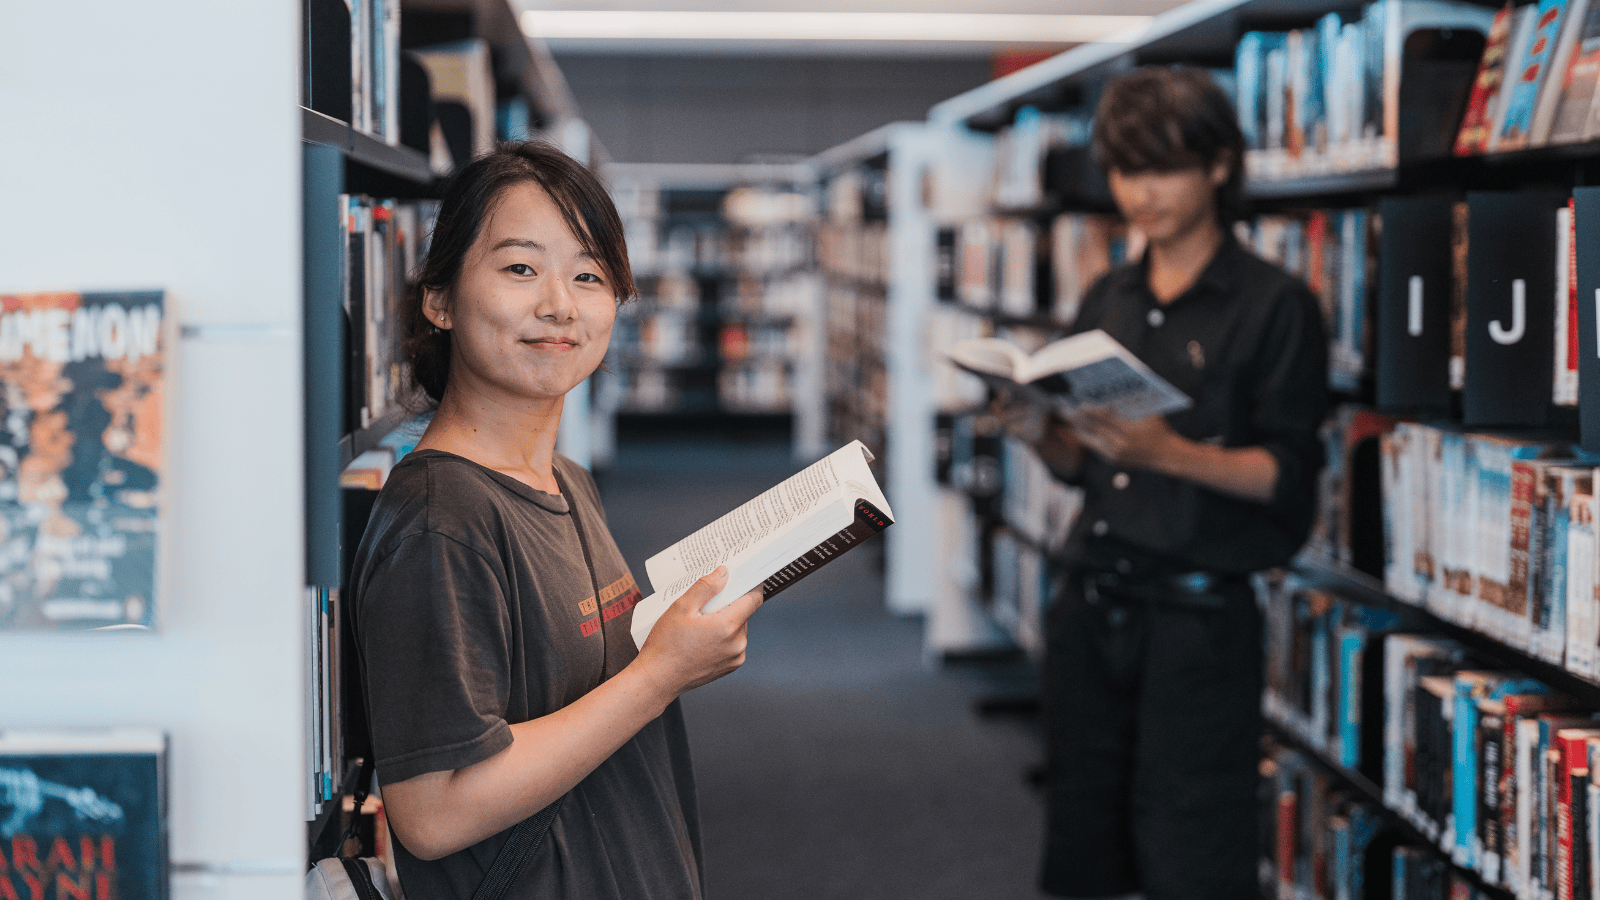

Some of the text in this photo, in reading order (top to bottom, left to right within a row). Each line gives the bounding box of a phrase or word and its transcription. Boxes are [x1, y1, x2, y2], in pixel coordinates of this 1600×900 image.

[1408, 275, 1424, 337] I
[1488, 278, 1526, 346] J
[859, 504, 884, 526] WORLD
[0, 835, 115, 872] RAH
